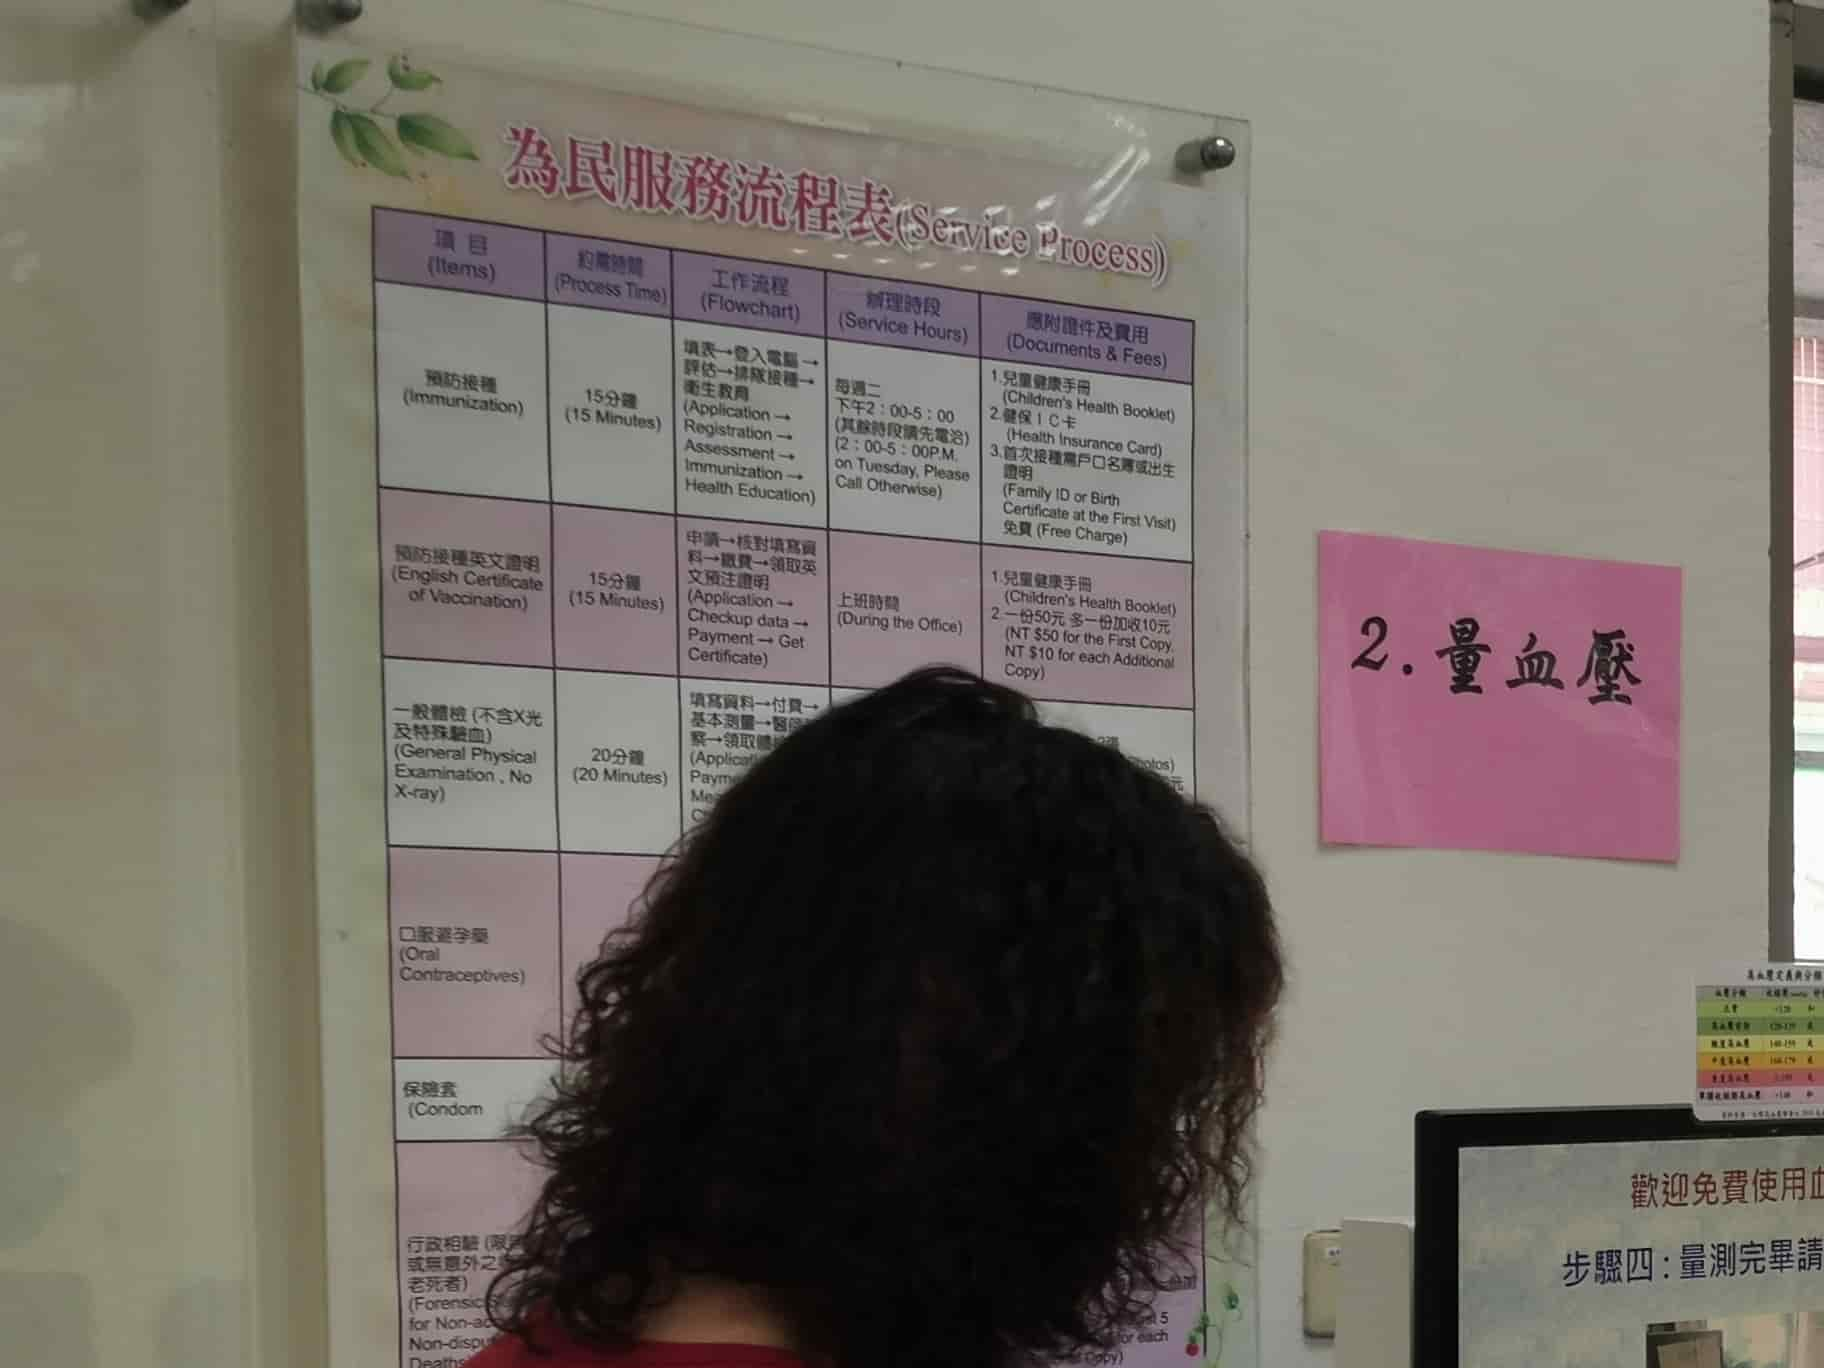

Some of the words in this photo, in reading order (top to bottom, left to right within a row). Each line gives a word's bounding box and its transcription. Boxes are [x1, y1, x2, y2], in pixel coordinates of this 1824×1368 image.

[507, 128, 893, 242] 為民服務流程表
[1039, 225, 1167, 283] Process)
[428, 255, 496, 284] (Items)
[555, 272, 621, 298] (Process
[626, 281, 668, 305] Time)
[712, 269, 789, 297] 工作流程
[701, 292, 801, 323] (Flowchart)
[839, 311, 910, 333] (Service
[914, 321, 969, 345] Hours)
[1007, 332, 1101, 361] (Documents
[1106, 347, 1118, 362] &
[1123, 349, 1168, 369] Fees)
[404, 387, 524, 416] (Immunization)
[684, 400, 771, 422] (Application
[1003, 389, 1072, 409] (Children's
[1077, 400, 1119, 416] Health
[1123, 404, 1175, 423] Booklet)
[565, 407, 591, 425] (15
[596, 409, 662, 432] Minutes)
[684, 419, 772, 441] Registration
[685, 440, 775, 461] Assessment
[1007, 427, 1055, 446] (Health
[1059, 435, 1123, 453] Insurance
[1127, 440, 1162, 458] Card)
[686, 459, 783, 480] Immunization
[835, 459, 853, 471] on
[924, 464, 970, 482] Please
[686, 477, 734, 495] Health
[739, 482, 816, 506] Education)
[835, 474, 862, 490] Call
[867, 477, 943, 500] Otherwise)
[1003, 482, 1051, 501] (Family
[1056, 488, 1070, 501] ID
[1074, 493, 1087, 503] or
[1091, 491, 1120, 507] Birth
[1003, 502, 1069, 520] Certificate
[1073, 510, 1084, 521] at
[1089, 511, 1109, 524] the
[1113, 512, 1141, 527] First
[1144, 515, 1176, 532] Visit)
[1036, 522, 1071, 538] (Free
[1075, 526, 1128, 547] Charge)
[392, 564, 458, 587] (English
[463, 571, 544, 592] Certificate
[408, 588, 427, 602] of
[430, 588, 528, 613] Vaccination)
[569, 590, 595, 607] (15
[600, 592, 665, 613] Minutes)
[688, 589, 773, 610] (Application
[1004, 590, 1075, 608] (Children's
[1080, 597, 1120, 611] Health
[1126, 599, 1177, 617] Booklet)
[688, 608, 753, 628] Checkup
[757, 614, 789, 628] data
[837, 610, 889, 631] (During
[893, 615, 914, 630] the
[919, 616, 963, 634] Office)
[688, 628, 753, 647] Payment
[778, 634, 805, 649] Get
[1005, 627, 1030, 642] (NT
[1034, 628, 1059, 643] $50
[1063, 630, 1080, 644] for
[1084, 632, 1104, 646] the
[1108, 633, 1137, 648] First
[688, 647, 768, 668] Certificate)
[1004, 645, 1025, 658] NT
[1029, 645, 1054, 660] $10
[1058, 647, 1075, 662] for
[1079, 650, 1111, 665] each
[1113, 652, 1175, 669] Additional
[1004, 662, 1045, 680] Copy)
[395, 743, 466, 761] (General
[471, 747, 537, 765] Physical
[395, 763, 495, 782] Examination
[509, 769, 533, 784] No
[573, 766, 599, 785] (20
[603, 767, 668, 788] Minutes)
[395, 783, 446, 803] X-ray)
[399, 945, 440, 965] (Oral
[400, 966, 525, 988] Contraceptives)
[408, 1102, 483, 1119] (Condom
[409, 1316, 430, 1331] for
